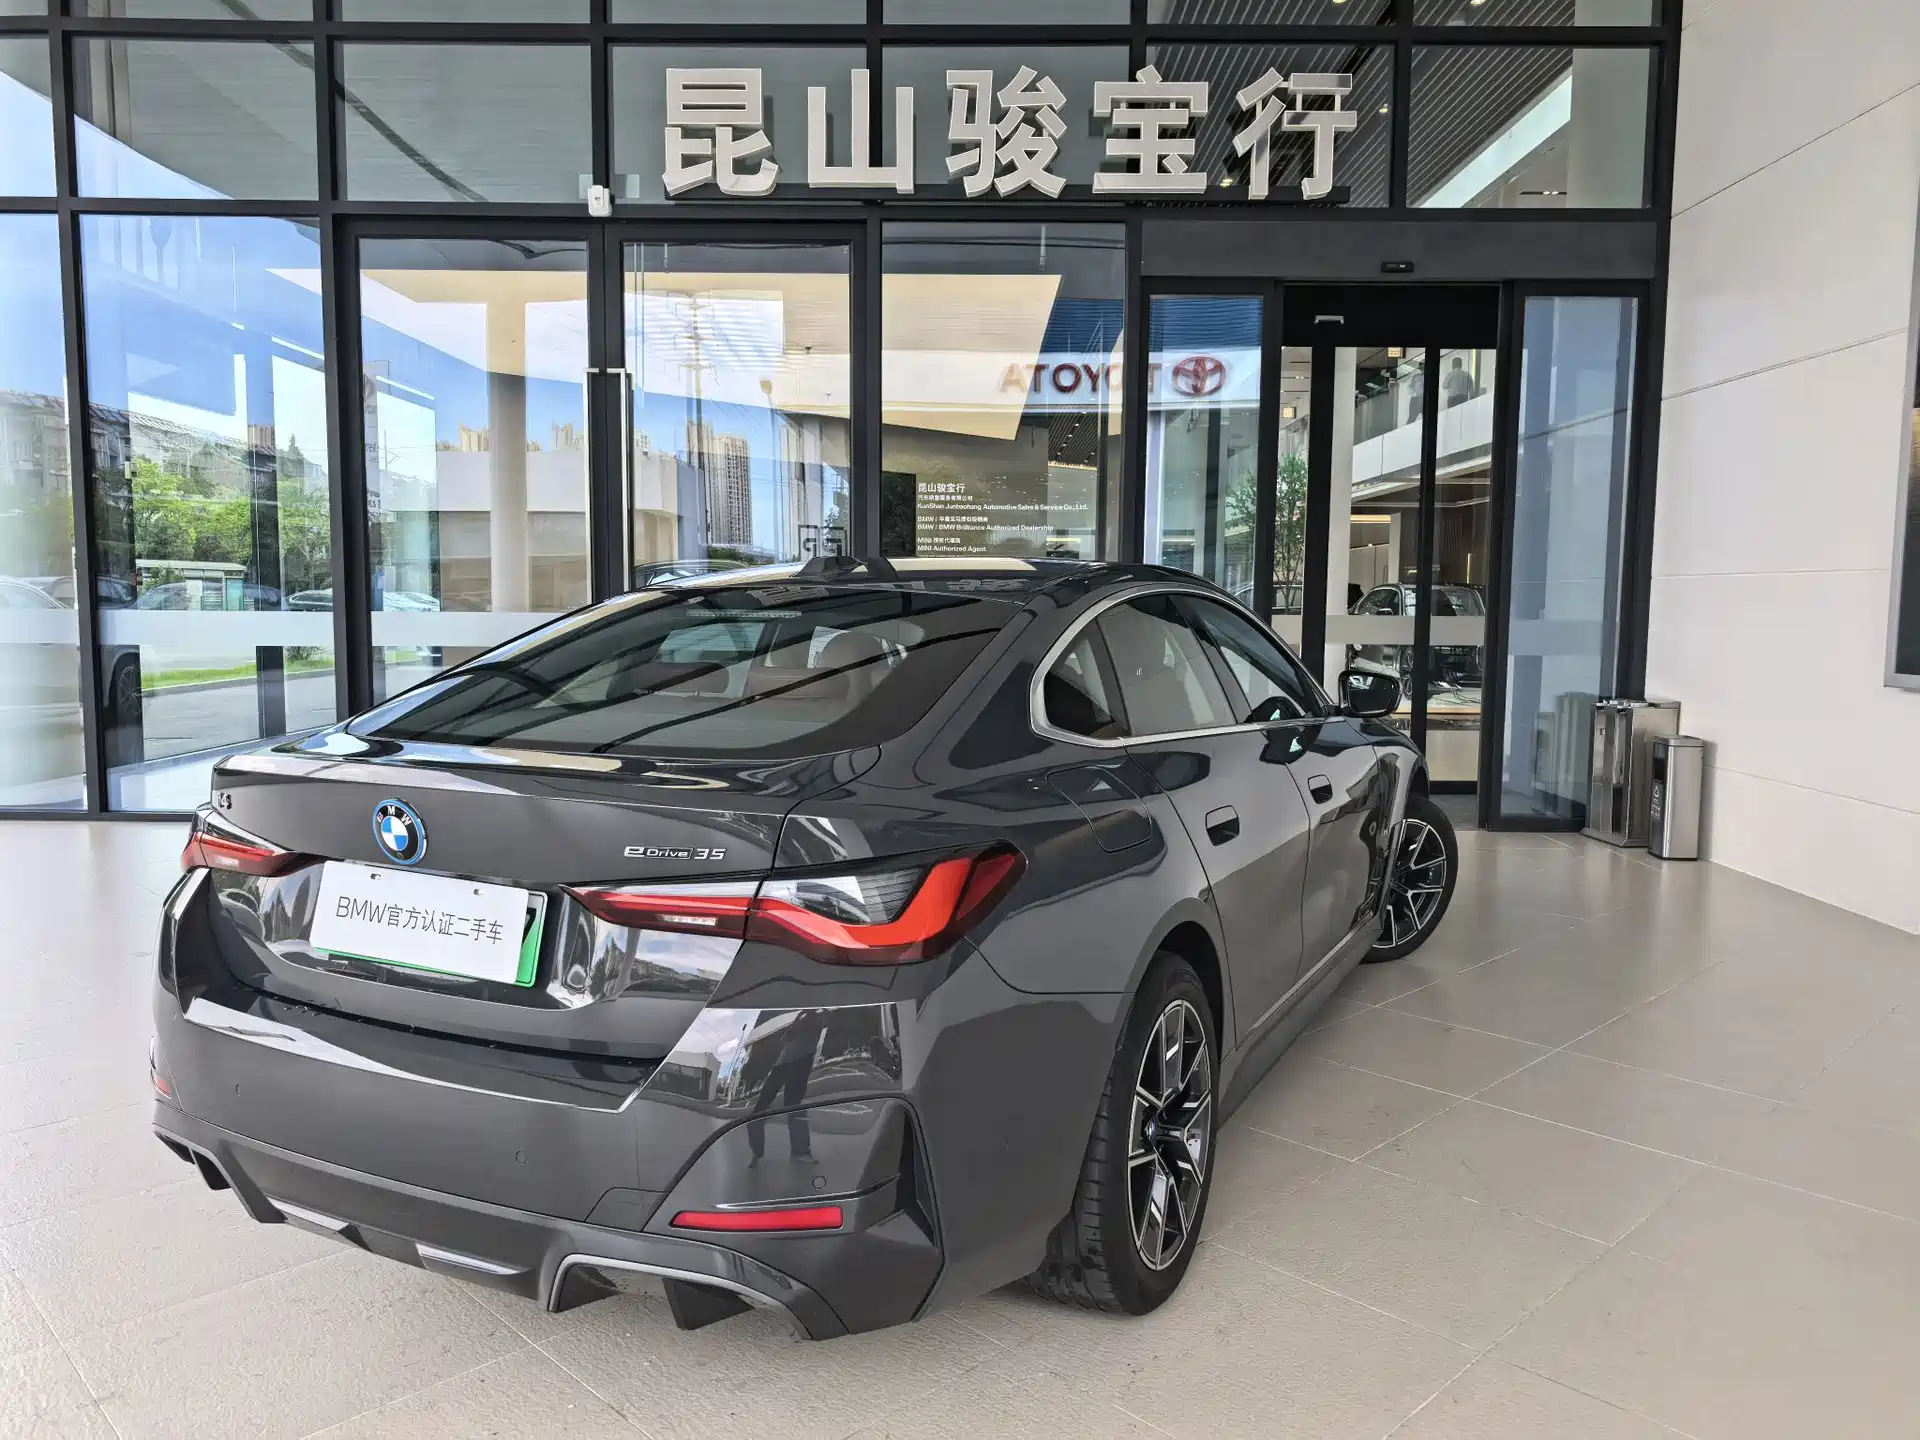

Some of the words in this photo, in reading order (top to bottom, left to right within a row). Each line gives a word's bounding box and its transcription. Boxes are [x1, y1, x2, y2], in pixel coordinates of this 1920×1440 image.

[662, 65, 1358, 199] 昆山骏宝行
[918, 483, 965, 493] 昆山骏宝行
[982, 503, 1017, 511] Automotive
[1040, 503, 1063, 511] Service
[986, 524, 1020, 532] Authorized
[376, 805, 412, 826] BMW
[694, 848, 727, 860] 35
[336, 896, 504, 945] BMW官方认证二手车
